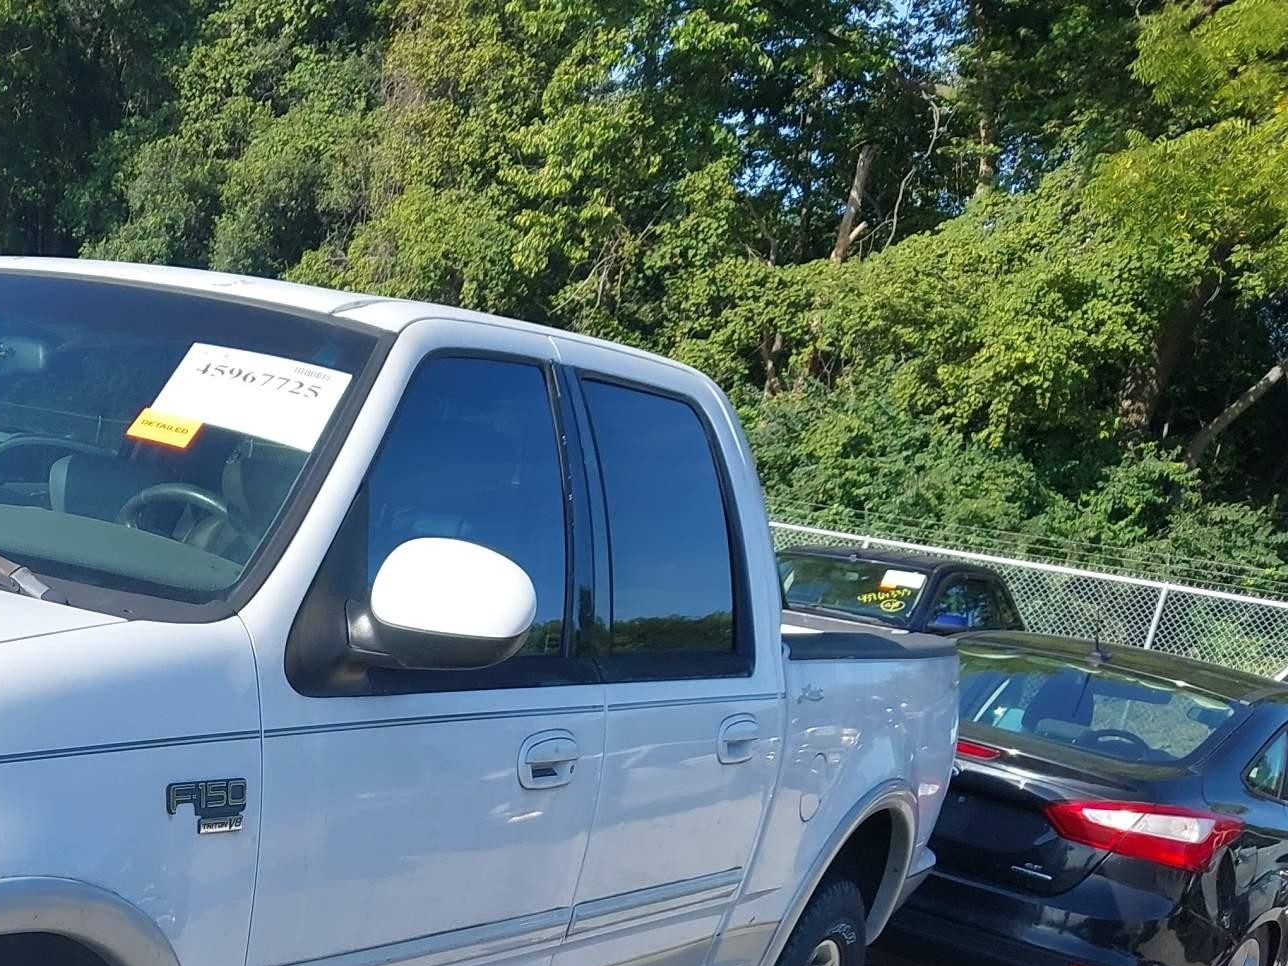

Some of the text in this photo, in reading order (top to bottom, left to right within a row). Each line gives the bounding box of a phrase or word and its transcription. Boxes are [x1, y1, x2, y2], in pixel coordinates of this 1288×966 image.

[196, 363, 322, 398] 45967725
[140, 418, 190, 436] DETAILED
[228, 817, 243, 830] V8
